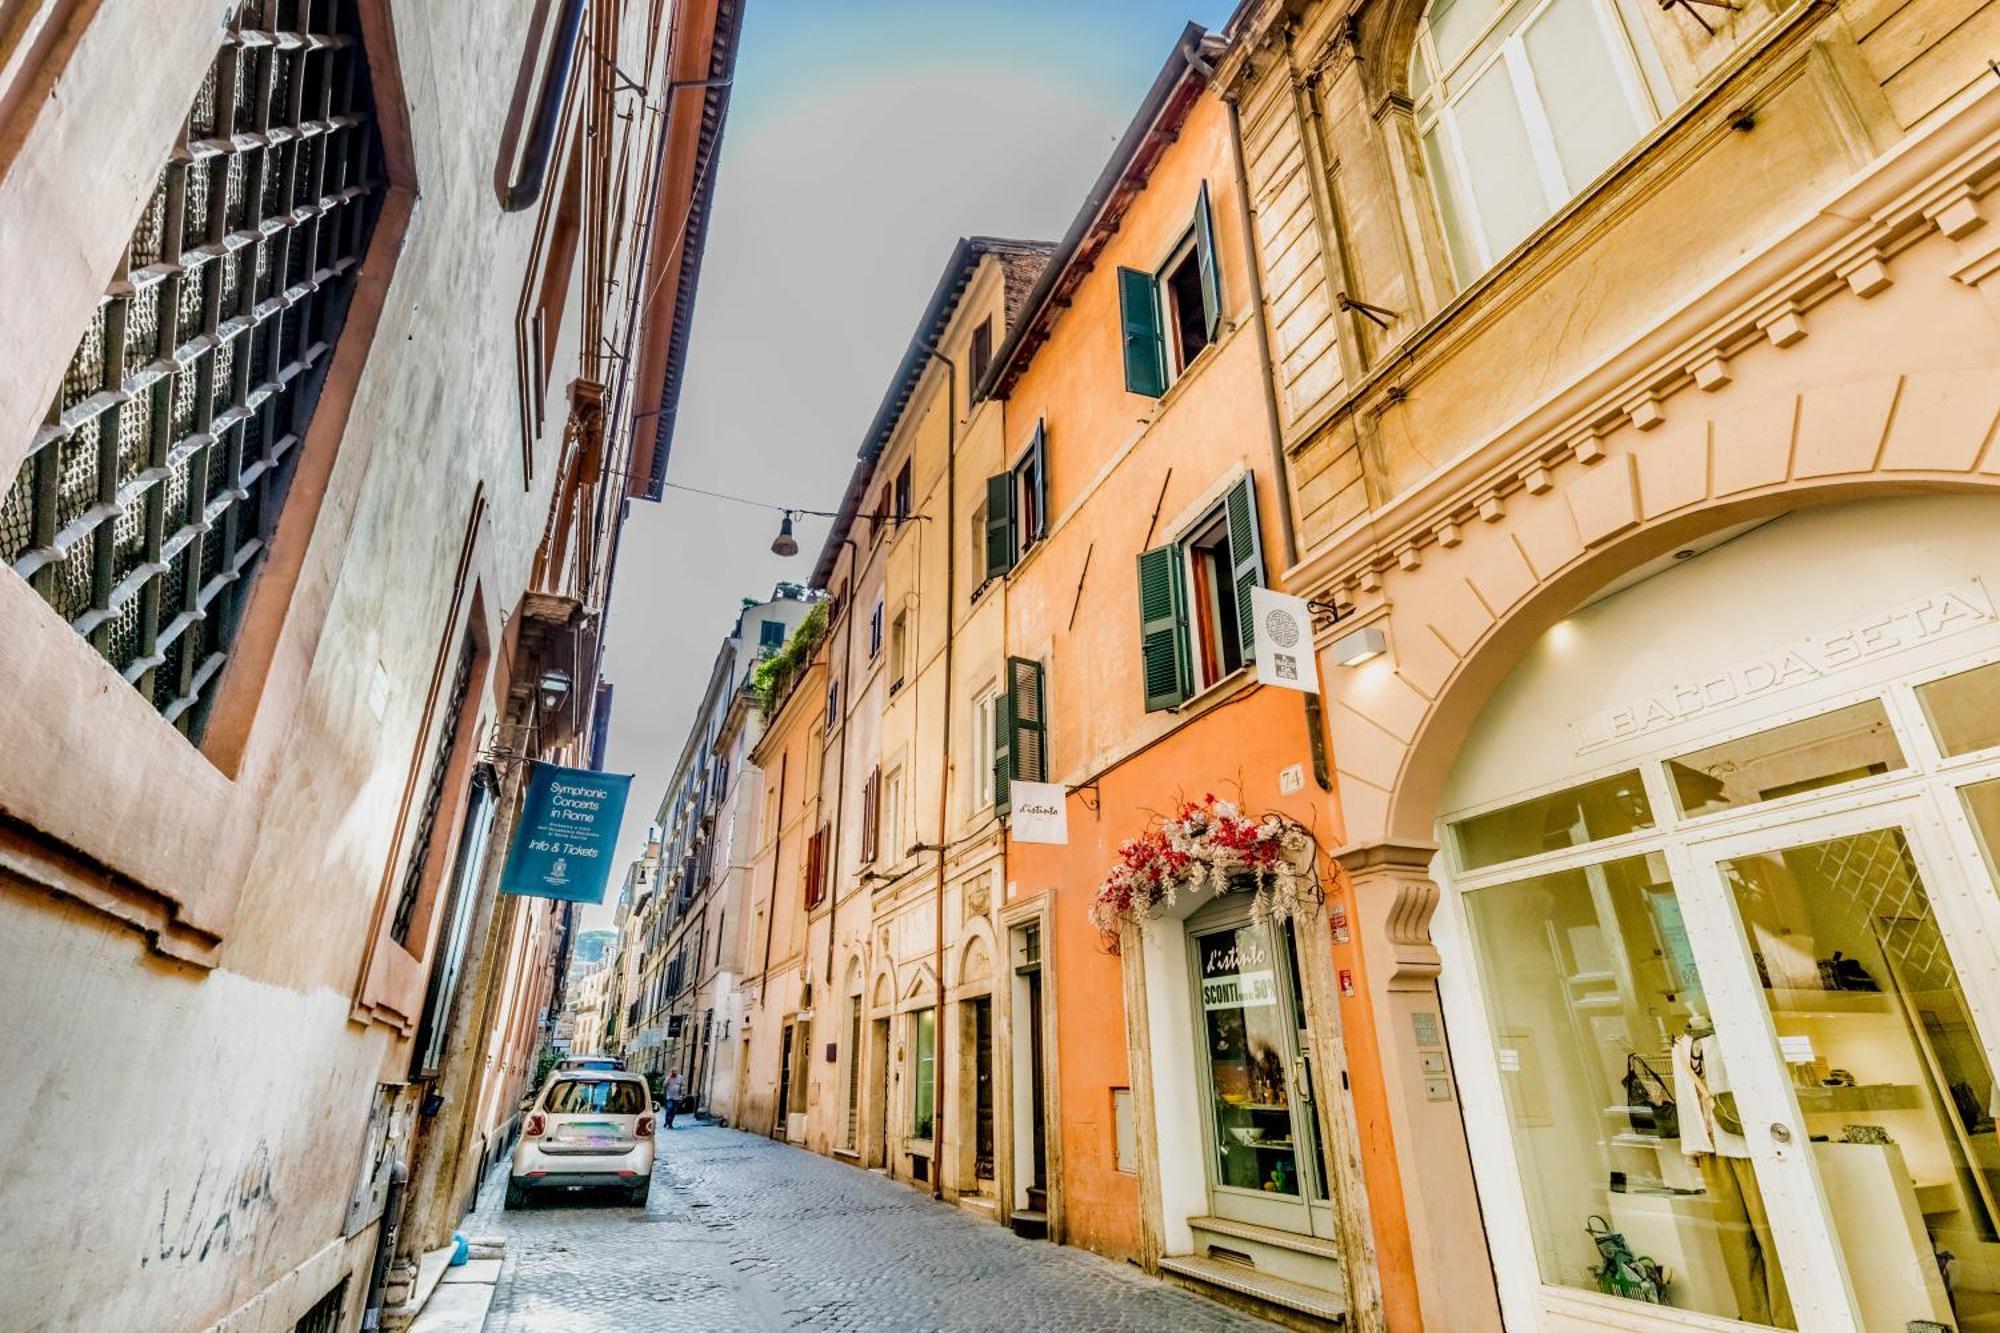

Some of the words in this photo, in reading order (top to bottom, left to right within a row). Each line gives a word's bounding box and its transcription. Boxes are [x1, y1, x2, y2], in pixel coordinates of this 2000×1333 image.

[1282, 769, 1300, 790] 74
[550, 782, 608, 799] Symphonic
[552, 795, 600, 811] Concerts
[550, 808, 561, 819] in
[562, 809, 595, 823] Rome
[529, 840, 550, 852] Info
[551, 842, 561, 853] &
[563, 843, 599, 858] Tickets
[1204, 982, 1239, 1005] SCONTI
